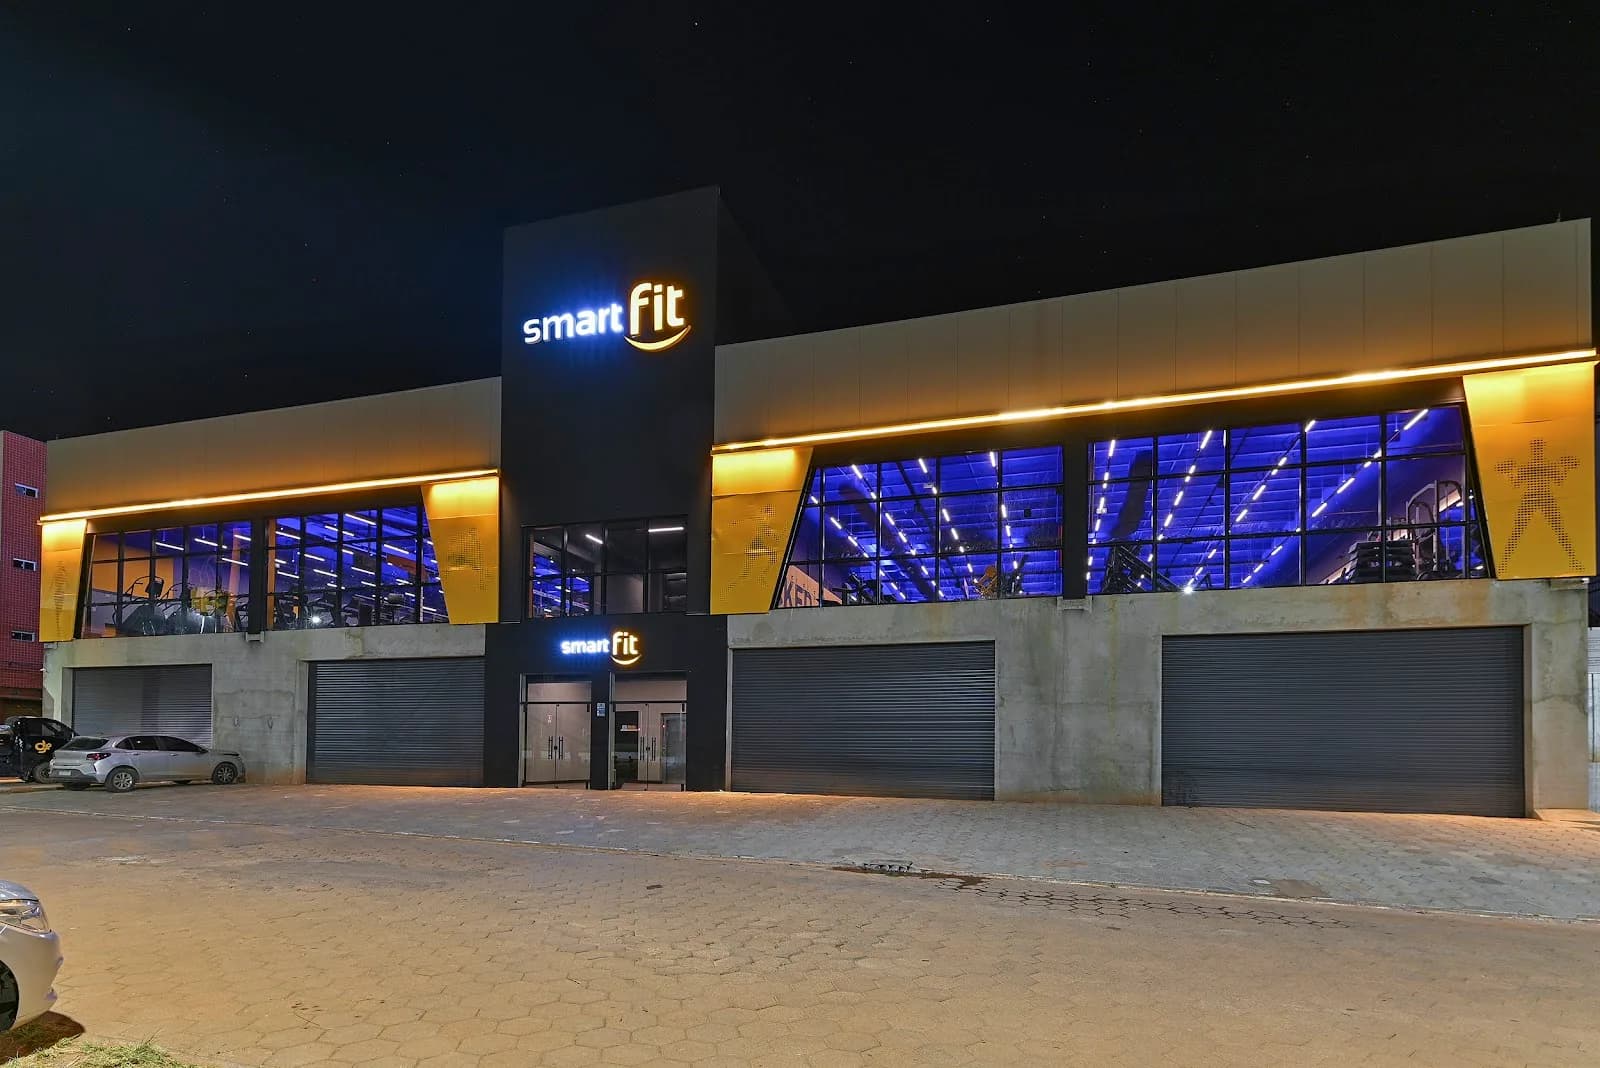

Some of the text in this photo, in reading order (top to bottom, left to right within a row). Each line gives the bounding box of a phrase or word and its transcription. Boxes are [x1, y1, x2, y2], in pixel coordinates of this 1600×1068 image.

[523, 282, 686, 345] smart fit
[560, 631, 639, 656] smart fit
